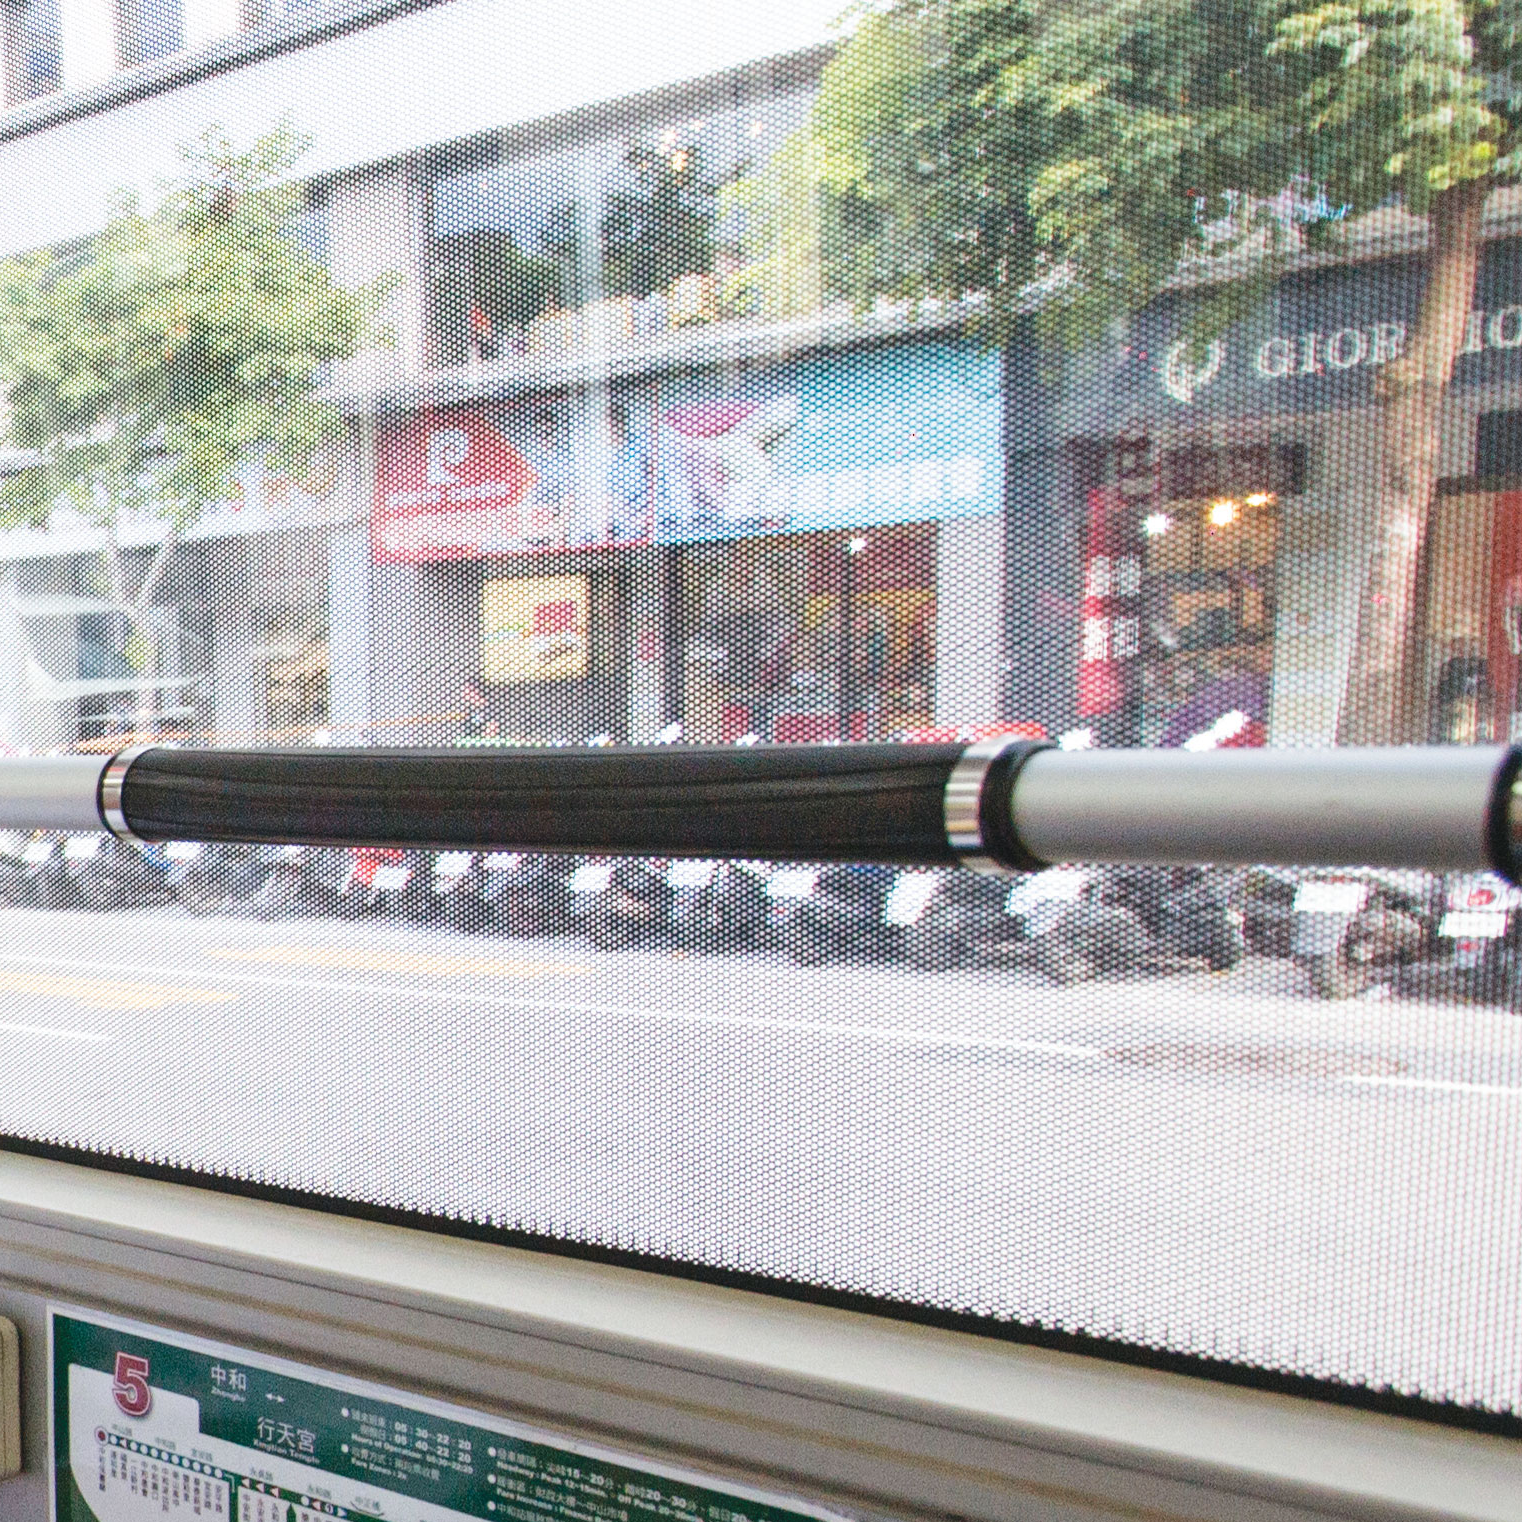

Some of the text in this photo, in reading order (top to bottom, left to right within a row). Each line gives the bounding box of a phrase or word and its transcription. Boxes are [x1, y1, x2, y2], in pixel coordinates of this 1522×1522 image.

[112, 1351, 152, 1416] 5
[211, 1364, 247, 1392] 中和
[257, 1416, 316, 1454] 行天宮
